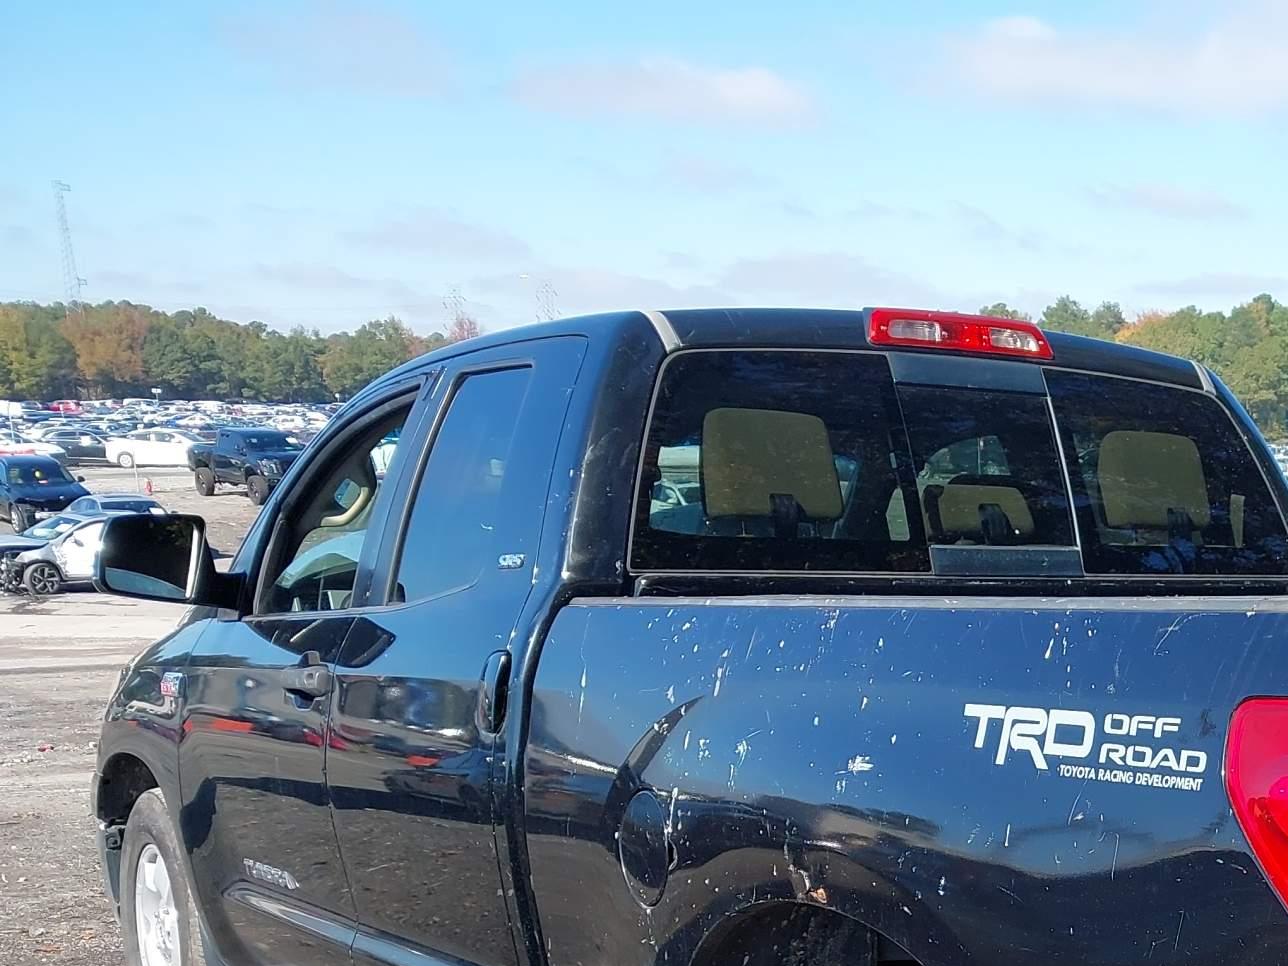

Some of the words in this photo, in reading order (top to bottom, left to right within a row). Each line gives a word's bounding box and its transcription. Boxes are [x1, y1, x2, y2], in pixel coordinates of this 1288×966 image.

[963, 702, 1096, 770] TRD
[1103, 713, 1182, 738] OFF
[1099, 743, 1208, 773] ROAD
[1058, 764, 1096, 781] TOYOTA
[1097, 768, 1134, 784] RACING
[1135, 773, 1203, 791] DEVELOPMENT
